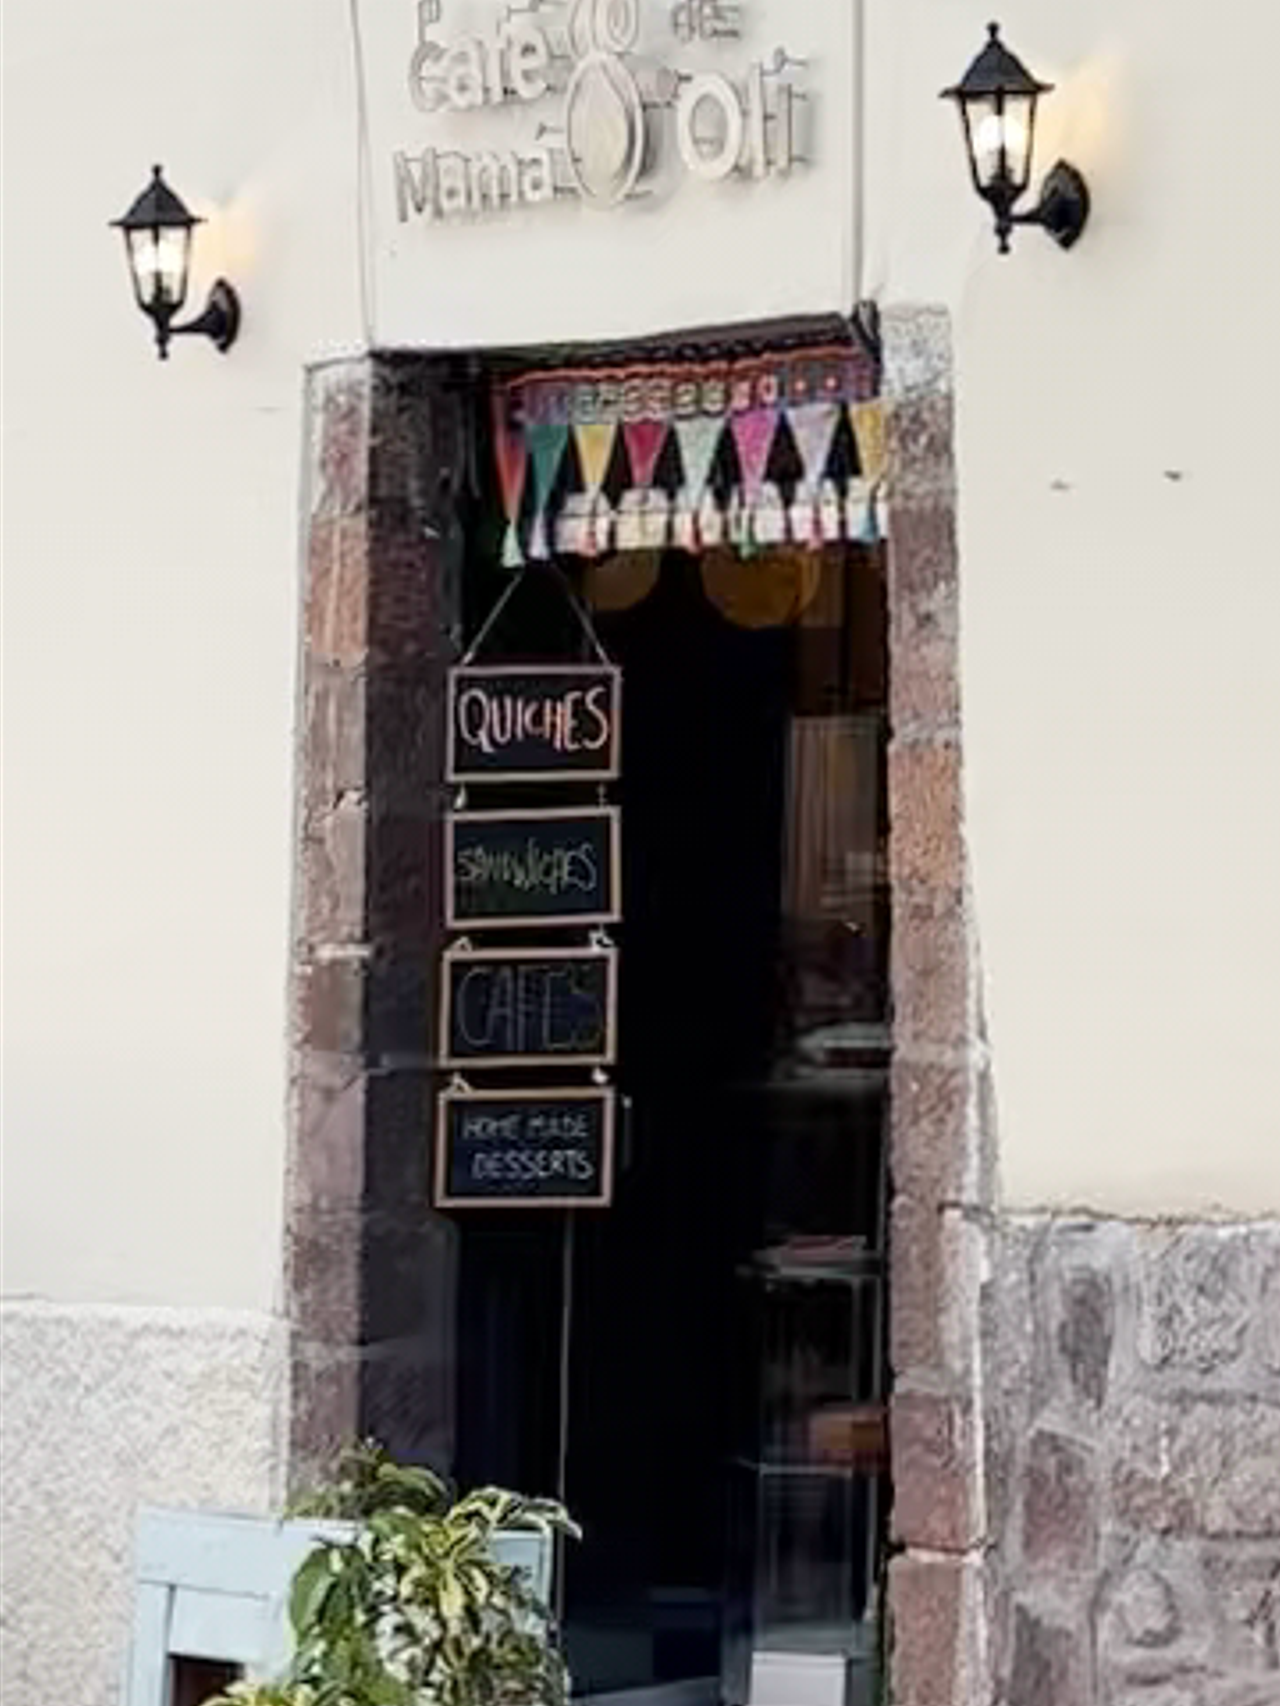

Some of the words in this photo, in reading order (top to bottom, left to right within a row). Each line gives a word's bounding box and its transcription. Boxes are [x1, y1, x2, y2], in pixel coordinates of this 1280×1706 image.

[676, 46, 795, 182] Oli
[457, 686, 609, 754] QUICHES
[471, 1149, 595, 1180] DESSERTS
